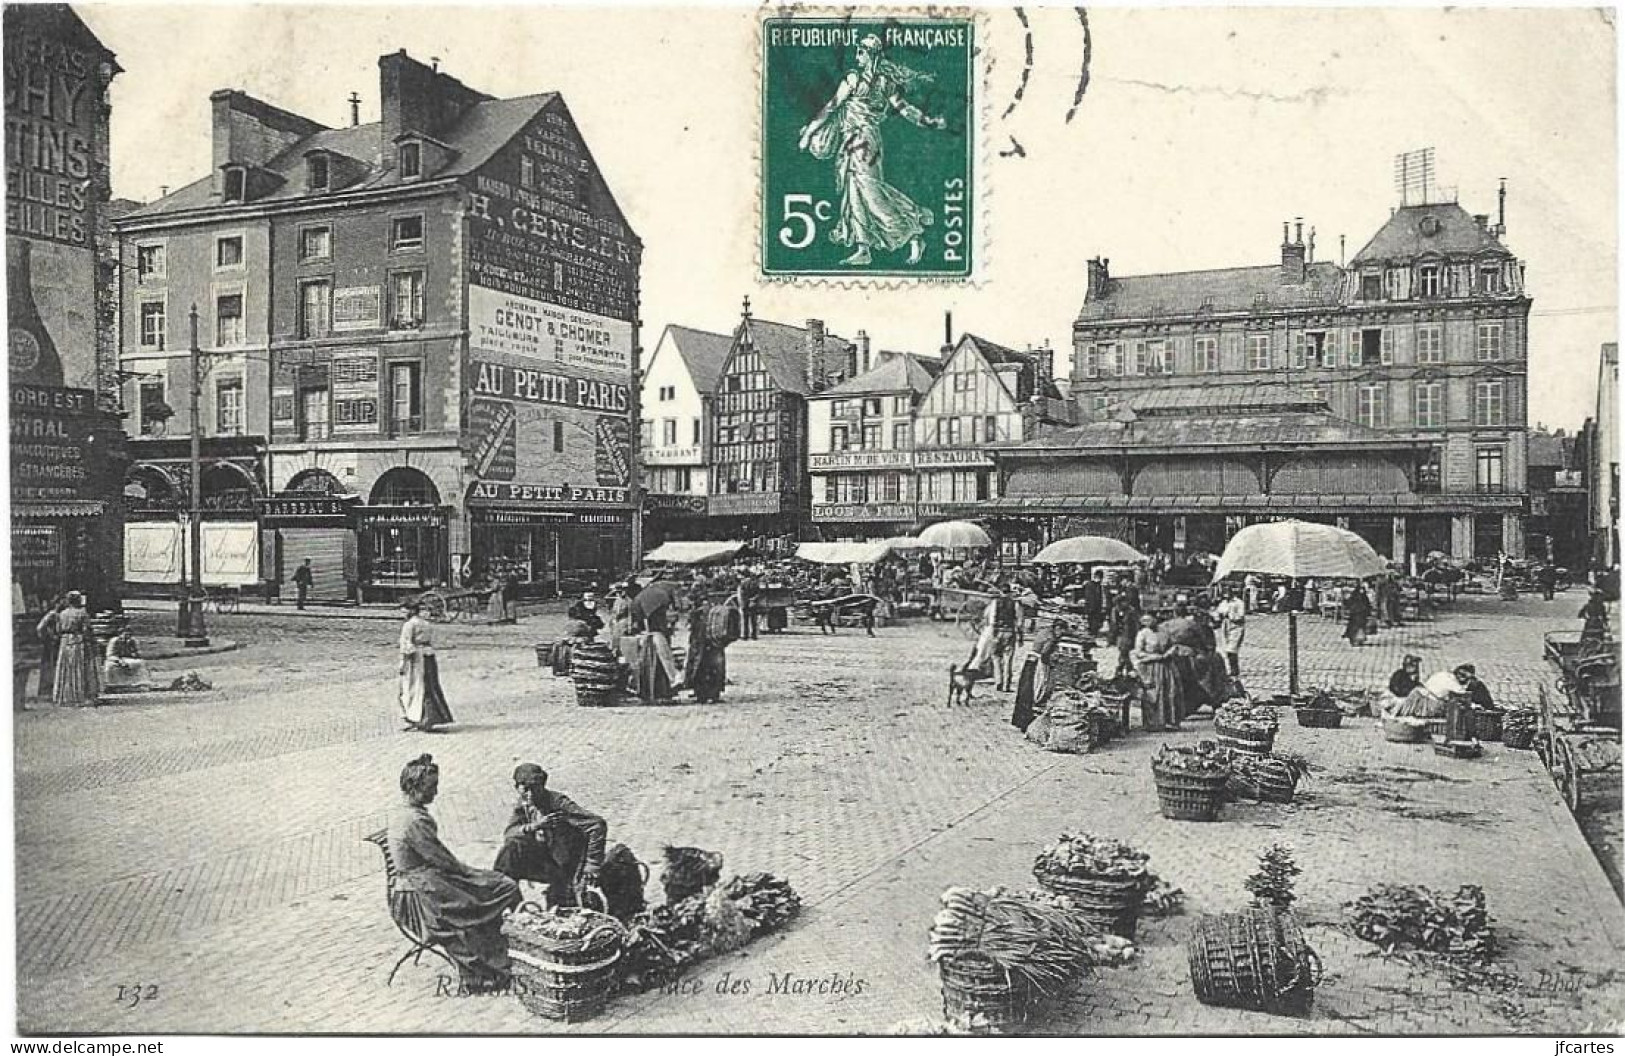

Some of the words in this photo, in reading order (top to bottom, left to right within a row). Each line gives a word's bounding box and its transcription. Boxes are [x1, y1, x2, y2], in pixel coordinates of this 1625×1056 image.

[885, 27, 965, 50] FRANÇAISE
[944, 177, 963, 260] POSTES
[496, 308, 542, 332] GENOT
[547, 321, 555, 336] &
[559, 323, 611, 346] CHOMER
[475, 363, 504, 395] AU
[513, 368, 569, 404] PETIT
[576, 379, 627, 411] PARIS
[54, 393, 83, 410] EST
[336, 399, 376, 422] LIP
[472, 484, 499, 498] AU
[509, 486, 563, 500] PETIT
[571, 489, 625, 502] PARIS
[715, 971, 751, 995] des
[765, 971, 866, 995] Marchés
[116, 984, 159, 1008] 132
